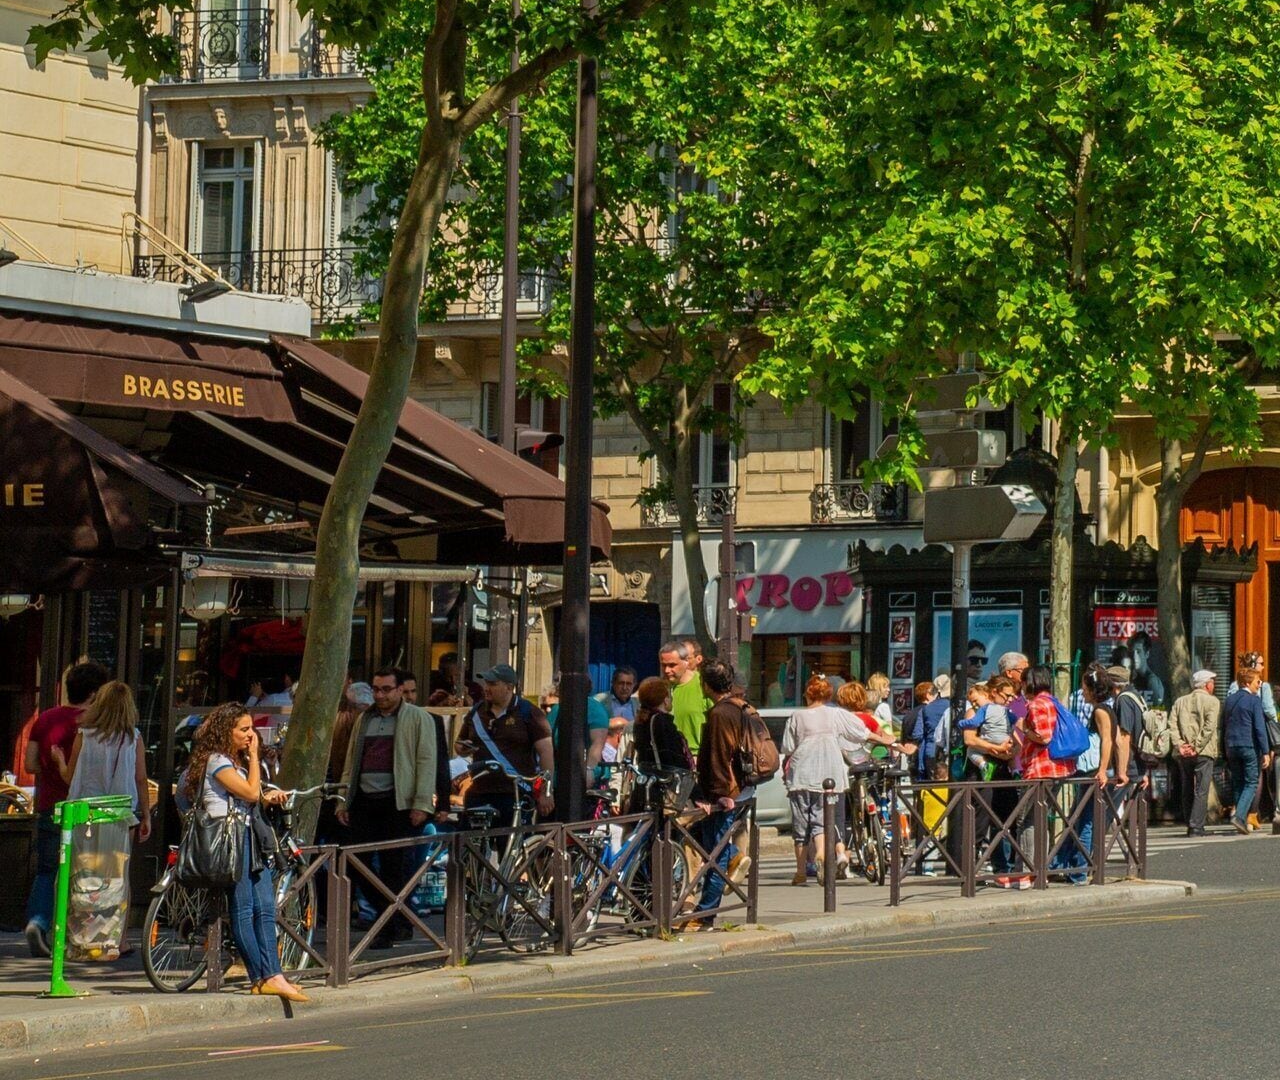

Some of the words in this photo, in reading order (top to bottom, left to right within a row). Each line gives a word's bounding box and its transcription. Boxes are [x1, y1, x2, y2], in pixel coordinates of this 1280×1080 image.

[123, 374, 245, 407] BRASSERIE
[969, 596, 996, 604] resse
[1097, 621, 1159, 637] L'EXPRES
